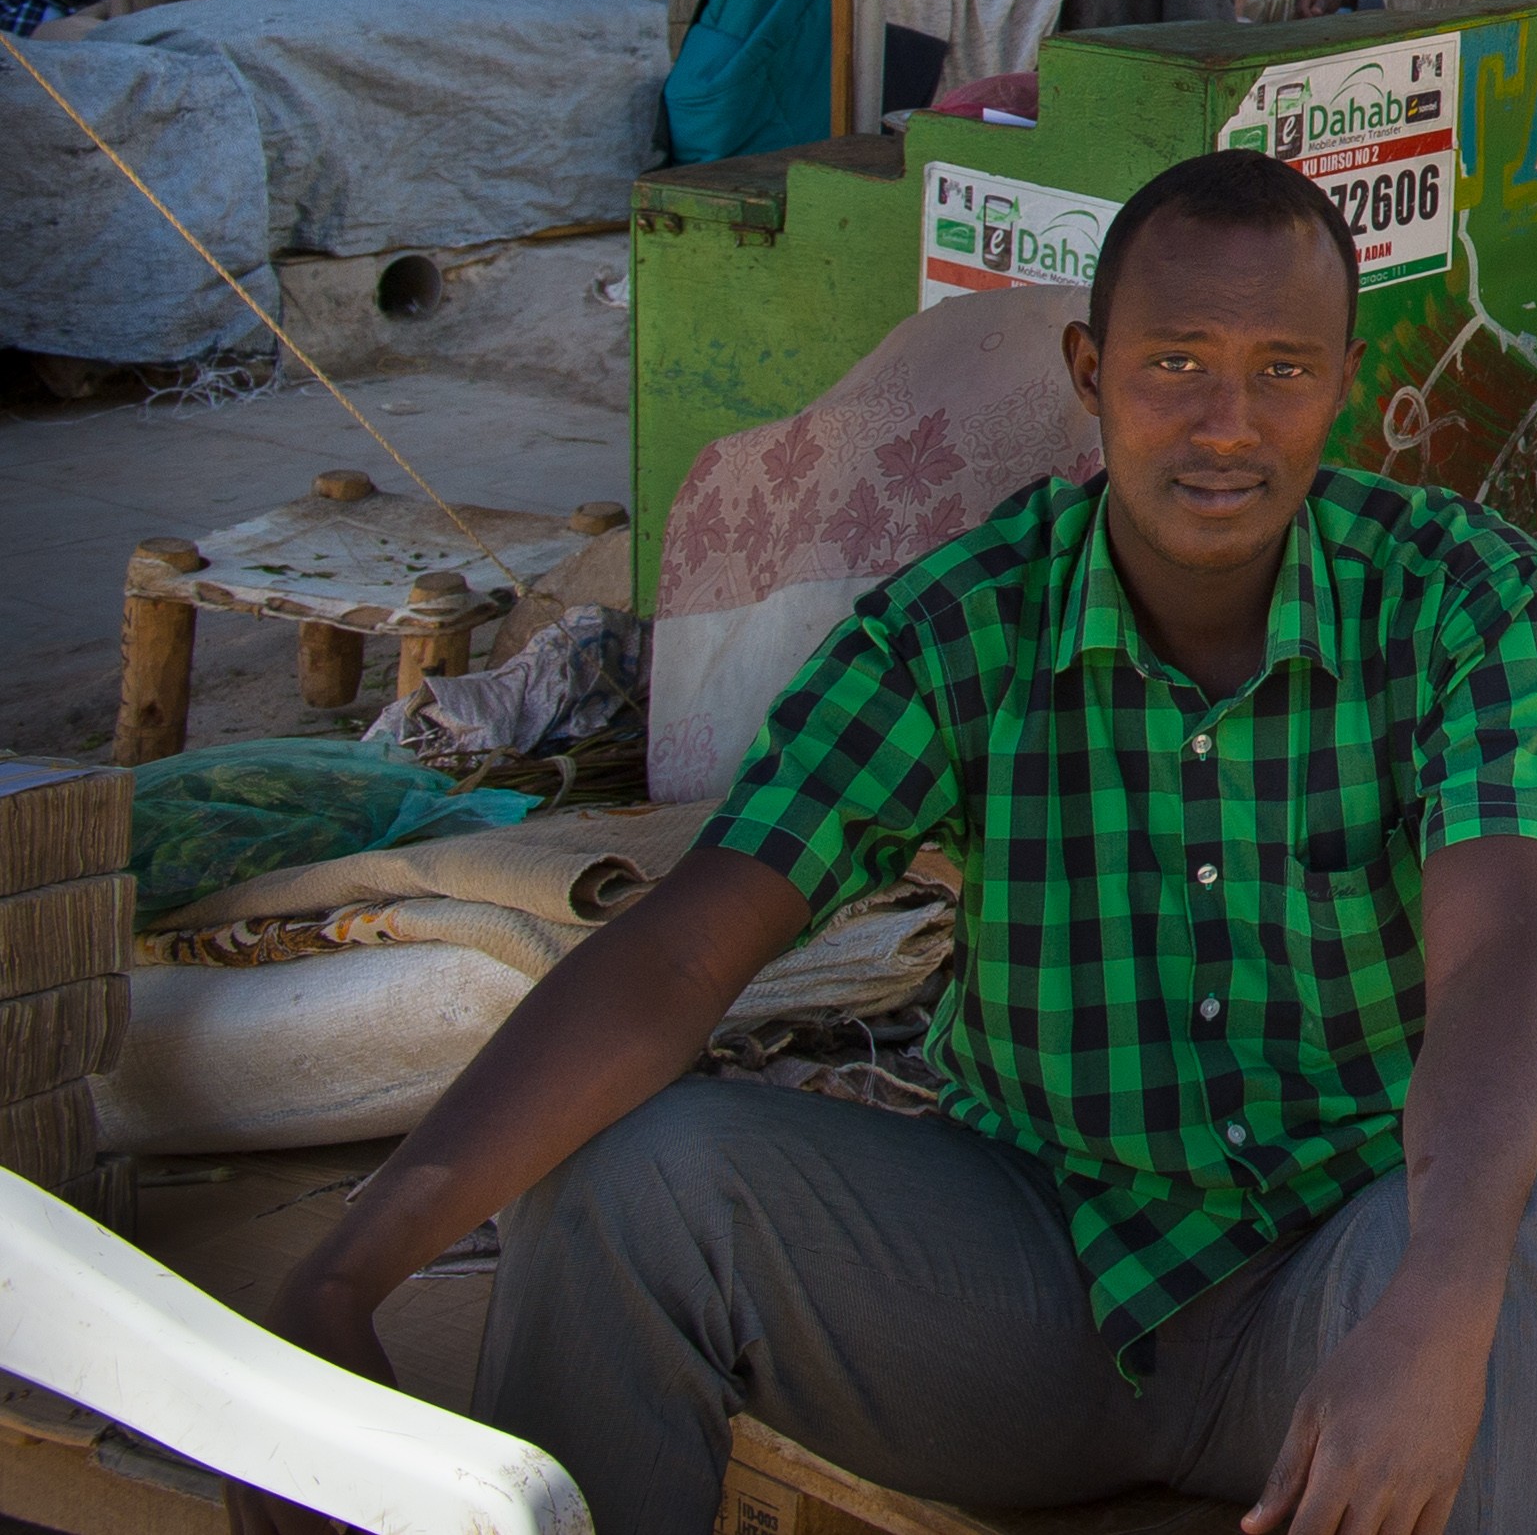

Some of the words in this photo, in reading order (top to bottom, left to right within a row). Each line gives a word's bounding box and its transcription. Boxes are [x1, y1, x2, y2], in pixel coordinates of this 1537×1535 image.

[1308, 138, 1338, 153] Mobile
[1337, 133, 1367, 149] Money
[1367, 124, 1403, 142] Transfer
[1302, 158, 1318, 177] KU
[1318, 151, 1353, 173] DIRSO
[1354, 148, 1371, 167] NO
[1371, 146, 1380, 163] 2
[1326, 163, 1441, 237] 72606
[1364, 241, 1393, 263] ADAN
[1017, 264, 1048, 281] Mobile
[1392, 265, 1407, 278] 111
